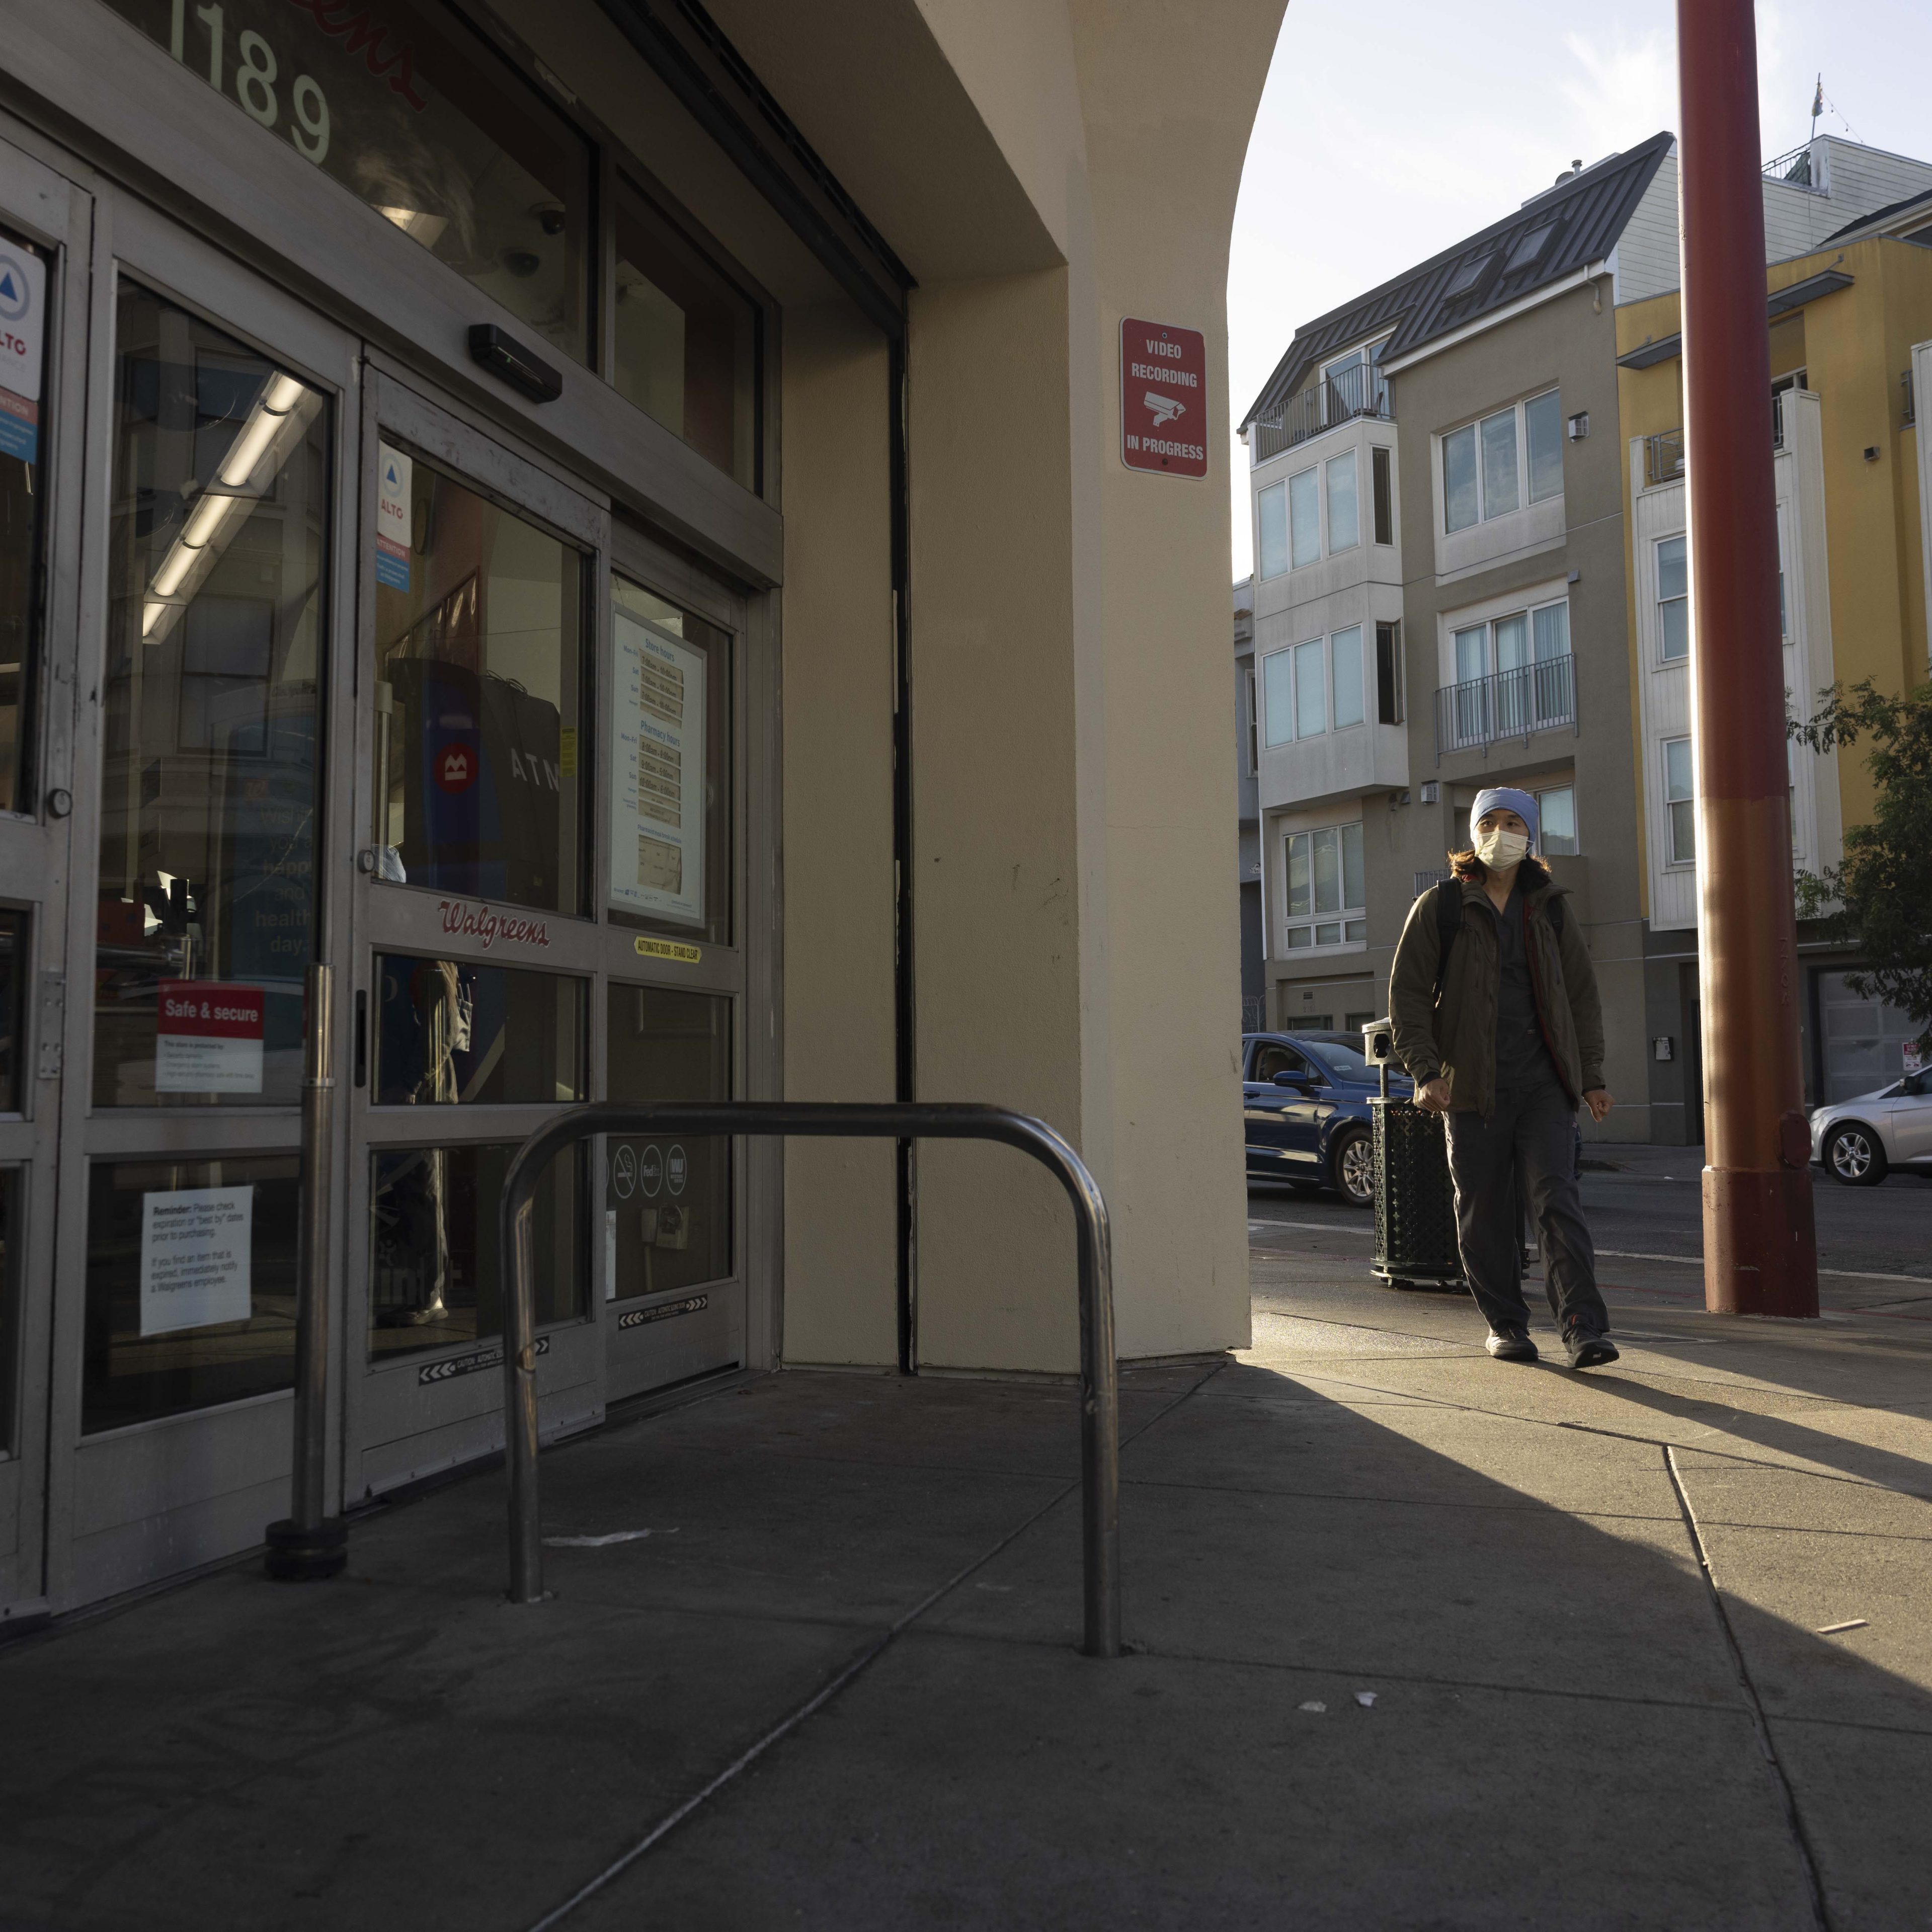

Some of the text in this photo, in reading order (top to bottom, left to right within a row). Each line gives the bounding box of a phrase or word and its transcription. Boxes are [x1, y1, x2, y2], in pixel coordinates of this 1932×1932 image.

[287, 0, 429, 114] ens
[1146, 339, 1181, 359] VIDEO
[1132, 362, 1197, 387] RECORDING
[1127, 435, 1203, 460] IN PROGRESS
[381, 499, 403, 520] ALTO
[377, 538, 406, 557] ATTENTION
[646, 638, 675, 662] Store hours
[630, 684, 638, 693] Sun
[621, 732, 637, 744] Mon-Fri
[640, 720, 680, 747] Pharmacy hours
[629, 772, 637, 780] Sun
[270, 836, 298, 854] you
[264, 859, 312, 878] happ
[275, 887, 305, 901] and
[438, 899, 551, 950] Walgreens
[637, 940, 660, 953] AUTOMATIC
[660, 943, 671, 955] DOOR
[674, 946, 686, 958] STAND
[686, 948, 698, 960] CLEAR
[166, 998, 259, 1022] Safe & secure
[153, 1201, 235, 1216] Reminder: Please check
[152, 1218, 186, 1229] expiration
[226, 1213, 244, 1222] dates
[152, 1232, 168, 1243] prior
[170, 1231, 178, 1239] to
[151, 1250, 231, 1269] If you find an item that is
[181, 1264, 219, 1276] immediately
[221, 1261, 237, 1271] notify
[157, 1279, 192, 1292] Walgreens
